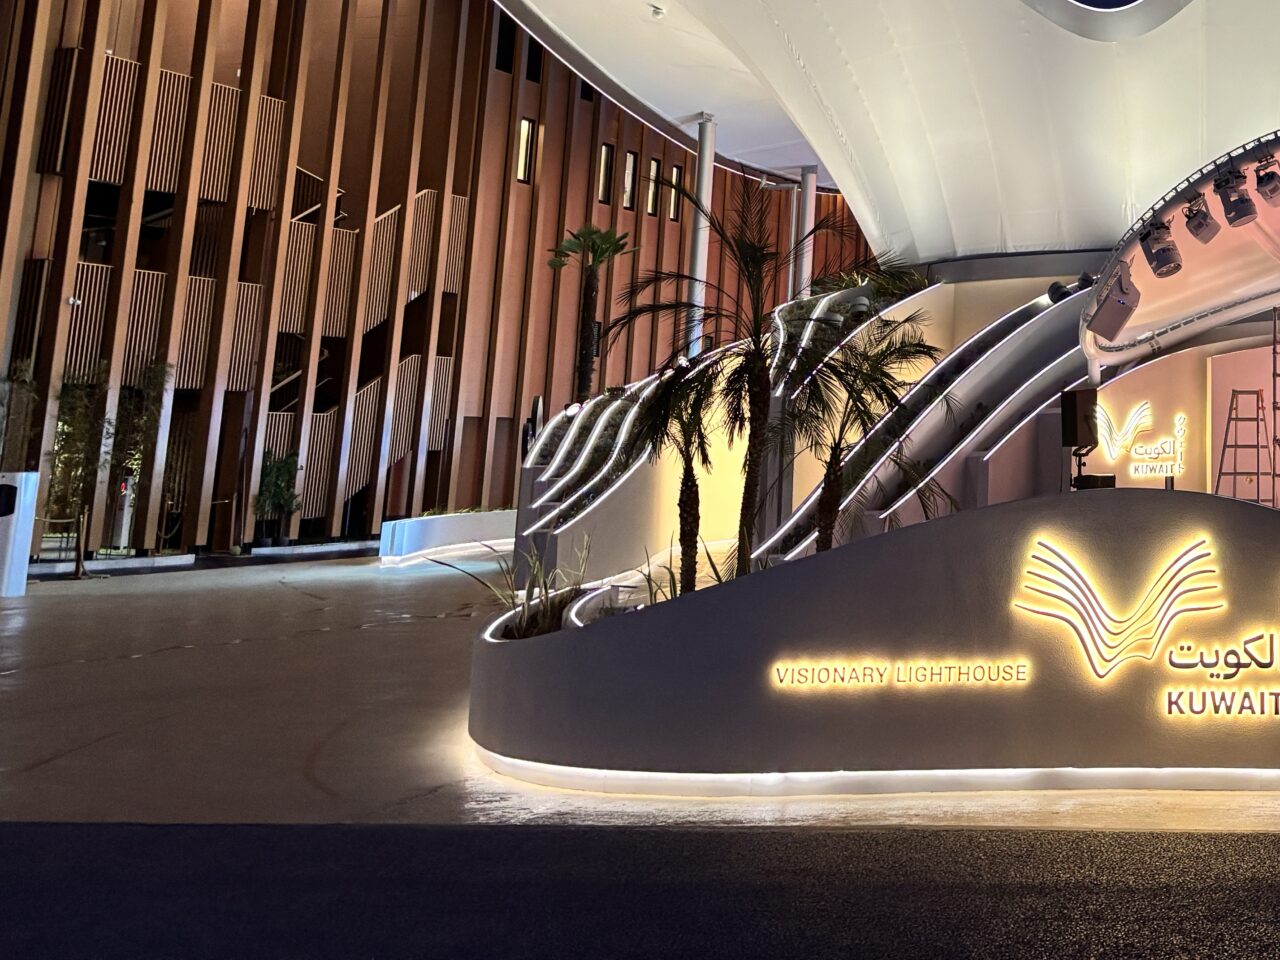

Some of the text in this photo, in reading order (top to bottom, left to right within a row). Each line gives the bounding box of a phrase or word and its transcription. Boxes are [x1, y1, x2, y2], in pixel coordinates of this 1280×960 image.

[1134, 440, 1175, 460] الكويت
[1133, 464, 1176, 474] KUWAIT
[776, 664, 1027, 685] VISIONARY LIGHTHOUSE
